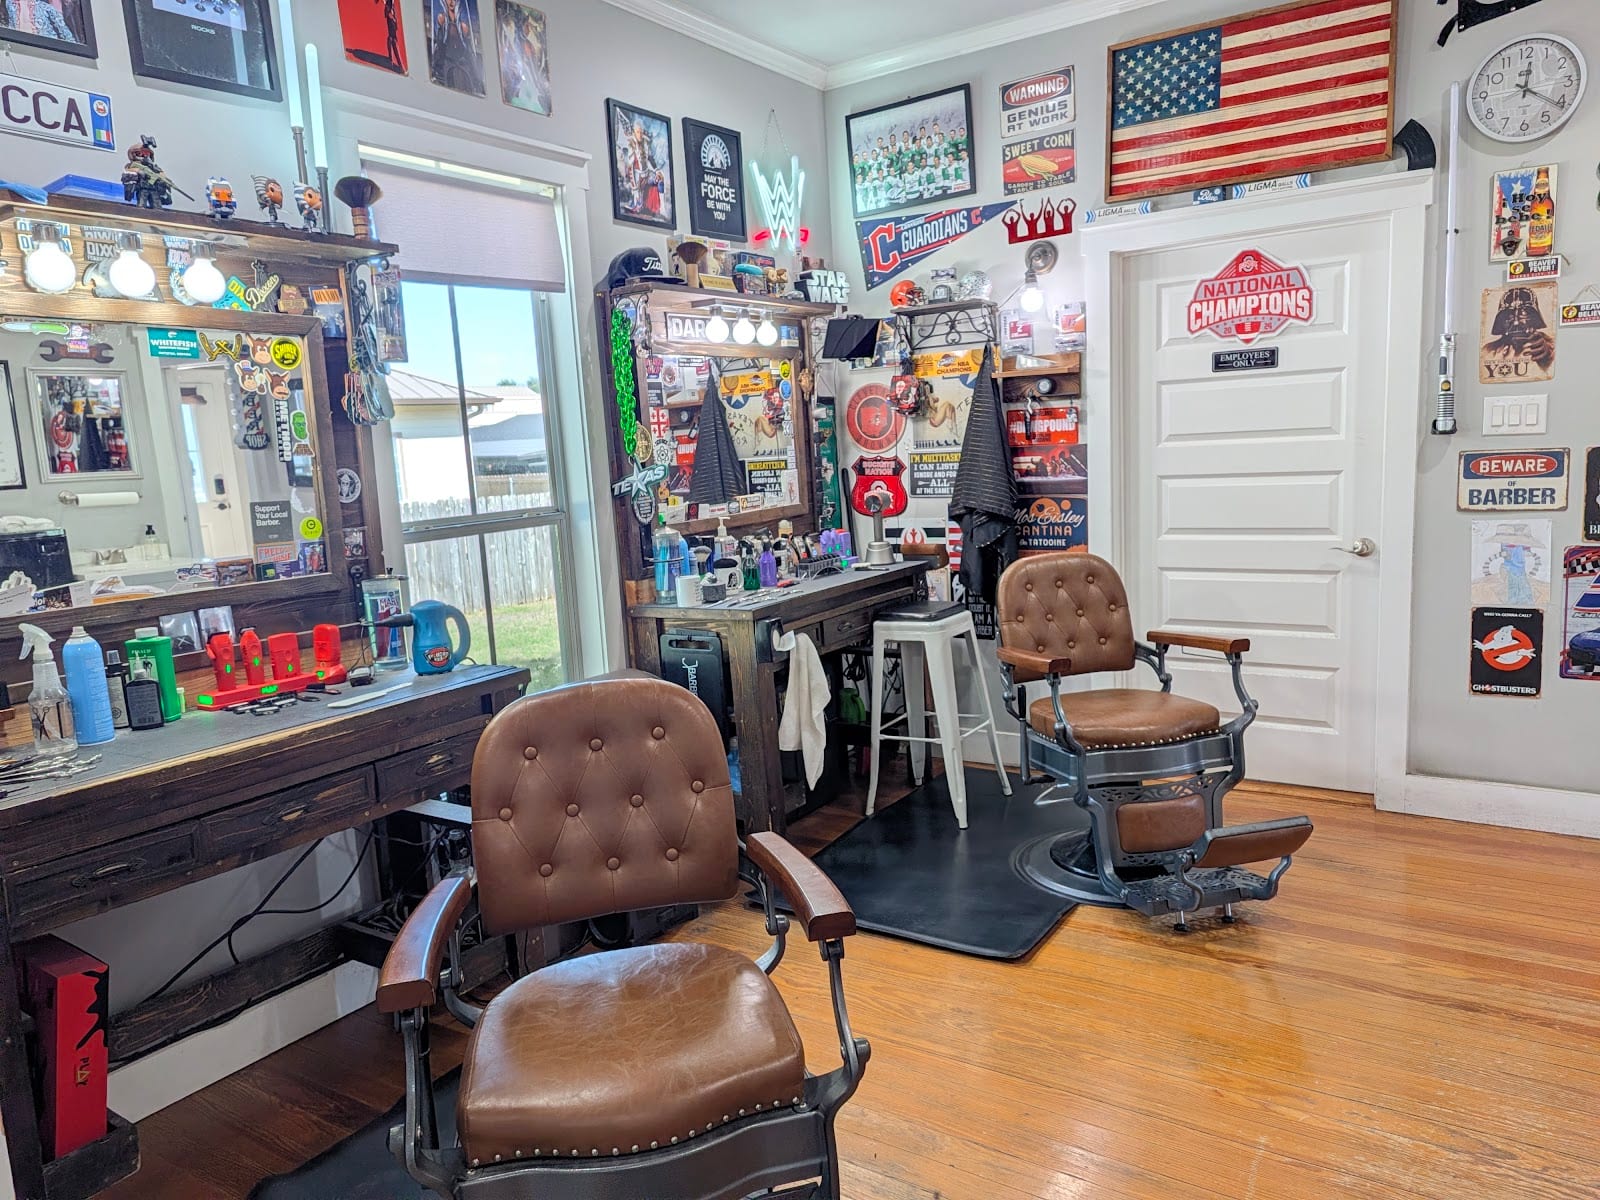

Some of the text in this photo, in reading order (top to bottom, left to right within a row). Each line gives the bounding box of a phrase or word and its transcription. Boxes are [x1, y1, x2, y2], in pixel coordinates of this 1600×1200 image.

[1520, 47, 1534, 60] 12
[1544, 48, 1549, 59] 1
[1502, 57, 1511, 69] 11
[1557, 57, 1567, 70] 2
[1486, 72, 1504, 86] 10
[1563, 75, 1573, 88] 3
[1010, 76, 1065, 103] WARNING
[1479, 91, 1488, 102] 9
[1556, 94, 1566, 109] 4
[1008, 100, 1068, 123] GENIUS
[1485, 108, 1494, 120] 8
[1541, 111, 1550, 123] 5
[1008, 111, 1068, 133] AT WORK
[1502, 117, 1510, 129] 7
[1520, 119, 1529, 131] 6
[1004, 131, 1072, 161] SWEET CORN
[704, 174, 730, 187] MAY THE
[1049, 171, 1071, 181] TABLE
[701, 182, 736, 203] FORCE
[1248, 180, 1277, 192] LIGMA
[706, 199, 731, 212] BE WITH
[1098, 207, 1123, 217] LIGMA
[713, 211, 726, 221] YOU
[901, 211, 968, 252] GUARDIANS
[1529, 259, 1557, 267] BEAVER
[811, 271, 849, 287] STAR
[1204, 272, 1296, 298] NATIONAL
[807, 286, 851, 303] WARS
[1190, 288, 1310, 332] CHAMPIONS
[150, 339, 197, 348] WHITEFISH
[1220, 351, 1270, 361] EMPLOYEES
[1232, 359, 1256, 368] ONLY
[279, 400, 292, 461] METHOD
[1479, 458, 1548, 473] BEWARE
[1468, 487, 1556, 505] BARBER
[254, 504, 280, 513] Support
[256, 519, 281, 527] Barber.
[1037, 506, 1085, 528] Eisley
